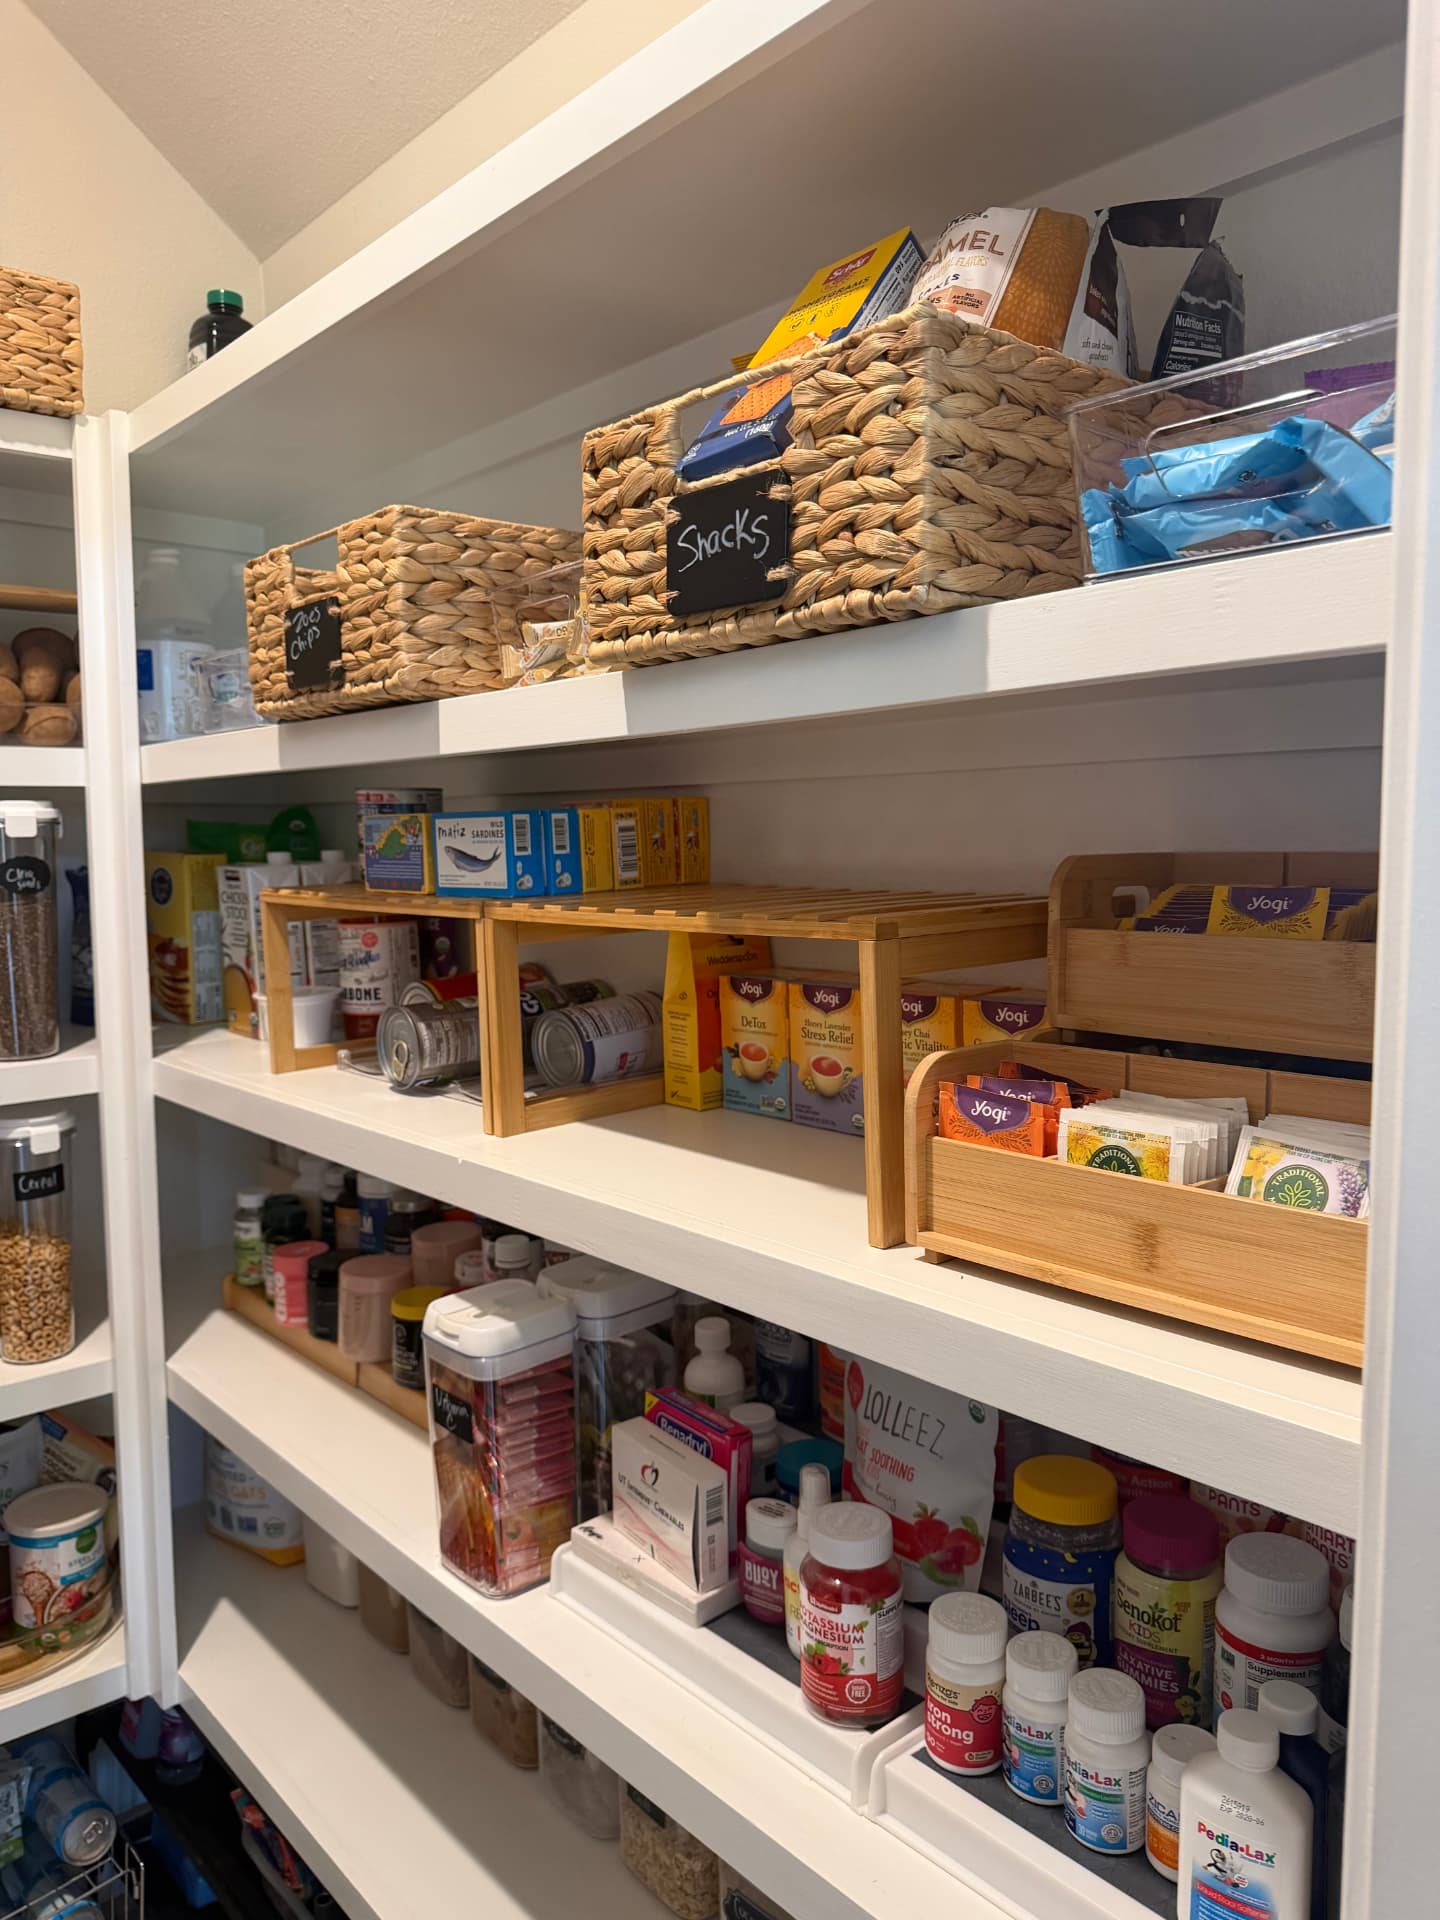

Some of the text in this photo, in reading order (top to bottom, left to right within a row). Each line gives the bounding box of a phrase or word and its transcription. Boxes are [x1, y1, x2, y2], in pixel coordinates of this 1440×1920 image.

[951, 294, 984, 306] ARTIFICIAL
[952, 299, 980, 309] FLAVORS
[1175, 313, 1222, 334] Nutrition Facts
[1165, 360, 1193, 371] Calories
[677, 508, 770, 573] Snacks
[471, 829, 505, 840] SARDINES
[800, 1026, 855, 1046] Stress Relief
[803, 1018, 852, 1032] Honey Lavender
[913, 1028, 931, 1039] Chai
[1092, 1149, 1137, 1174] TRADITIONAL
[1270, 1168, 1326, 1198] TRADITIONAL
[863, 1383, 946, 1458] LOLLEEZ
[660, 1416, 708, 1457] Benadryl
[869, 1447, 916, 1483] SOOTHING
[1208, 1488, 1261, 1518] PANTS
[744, 1559, 779, 1590] BUOY
[801, 1604, 865, 1634] OTASSIUM
[1116, 1587, 1182, 1633] Senokot
[802, 1619, 865, 1645] AGNESIUM
[1128, 1618, 1161, 1643] KIDS
[1116, 1654, 1180, 1694] GUMMIES
[1118, 1644, 1174, 1680] LAXATIVE
[1247, 1661, 1306, 1680] Supplement
[850, 1690, 866, 1698] FREE
[1148, 1791, 1181, 1822] ZICA
